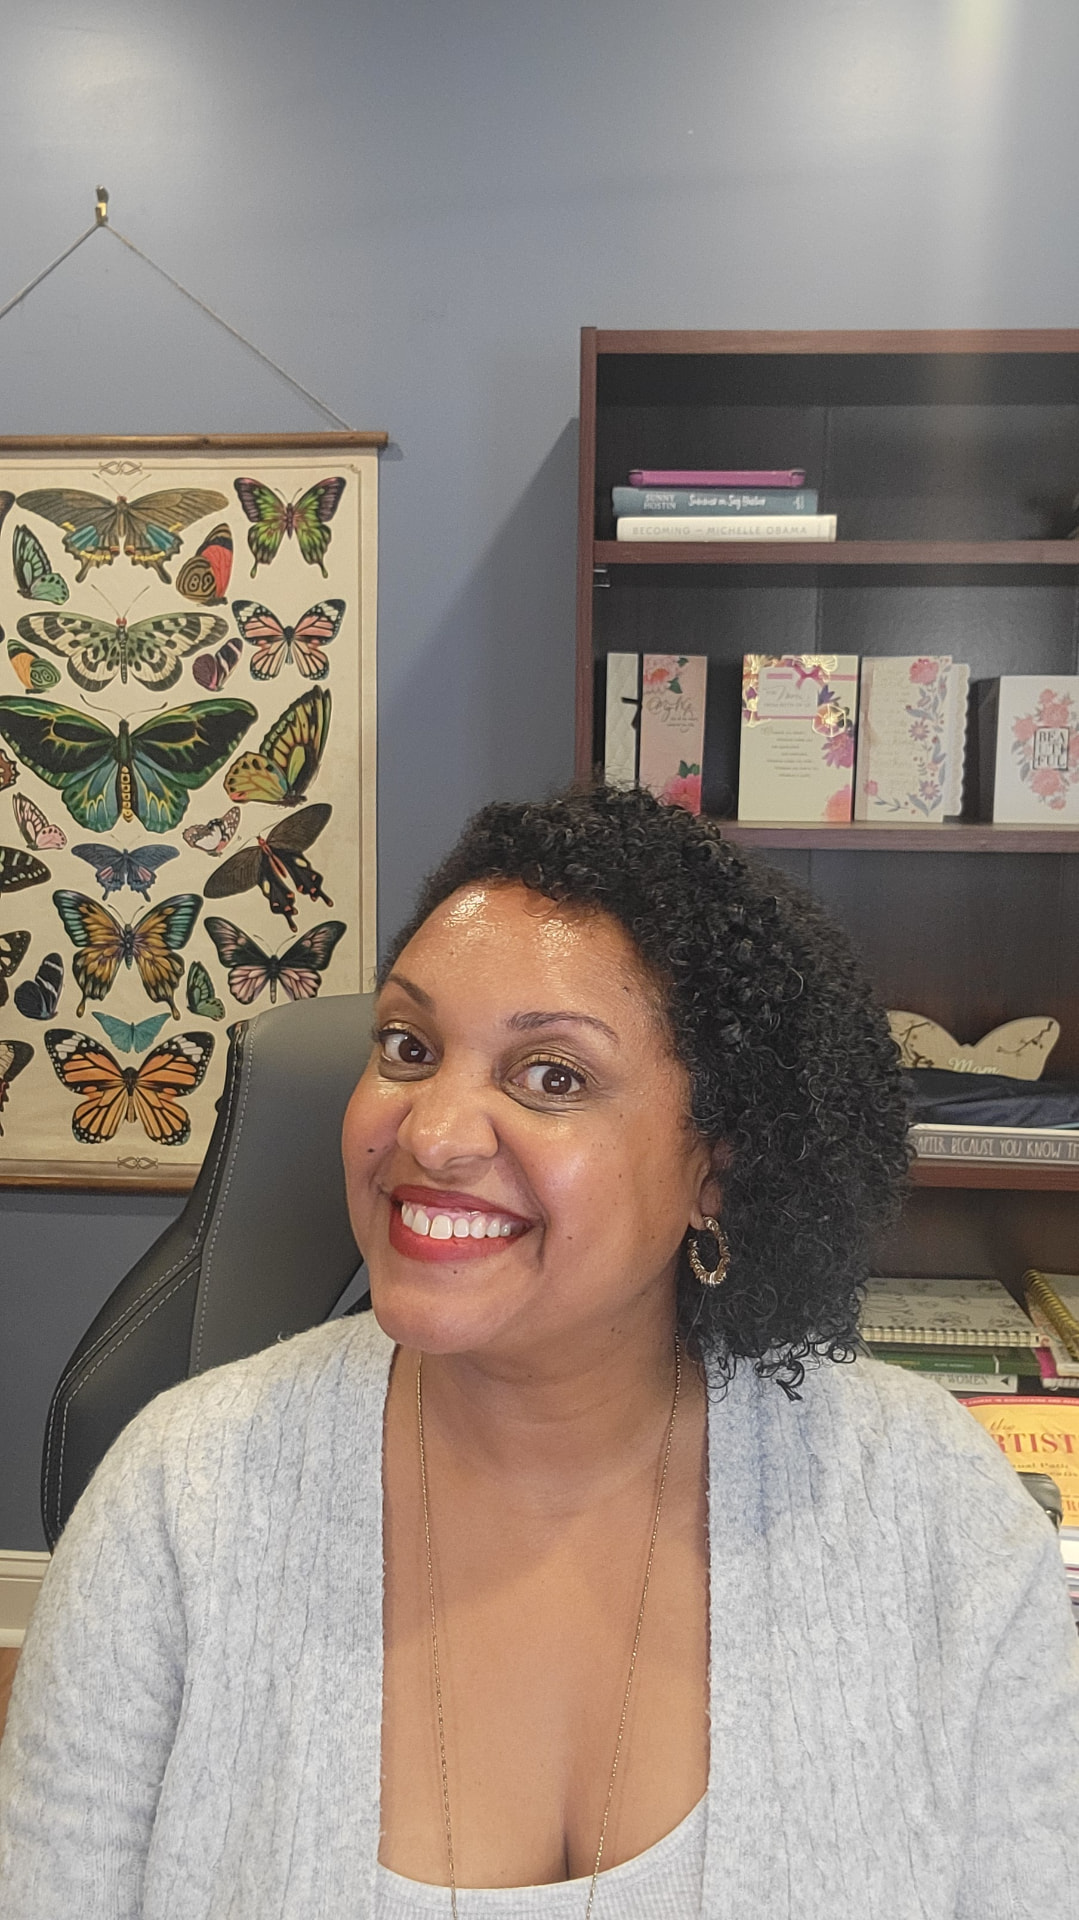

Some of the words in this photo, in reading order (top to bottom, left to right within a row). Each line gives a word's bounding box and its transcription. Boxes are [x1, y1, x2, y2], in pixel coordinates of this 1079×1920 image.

[632, 526, 690, 535] BECOMING
[706, 526, 761, 535] MICHELLE
[766, 526, 807, 535] OBAMA
[948, 1057, 1001, 1074] Mom
[951, 1137, 994, 1156] BECAUSE
[999, 1138, 1021, 1156] YOU
[1026, 1140, 1061, 1158] KNOW
[946, 1373, 989, 1385] WOMEN
[990, 1417, 1016, 1431] the
[991, 1432, 1077, 1454] RTIST
